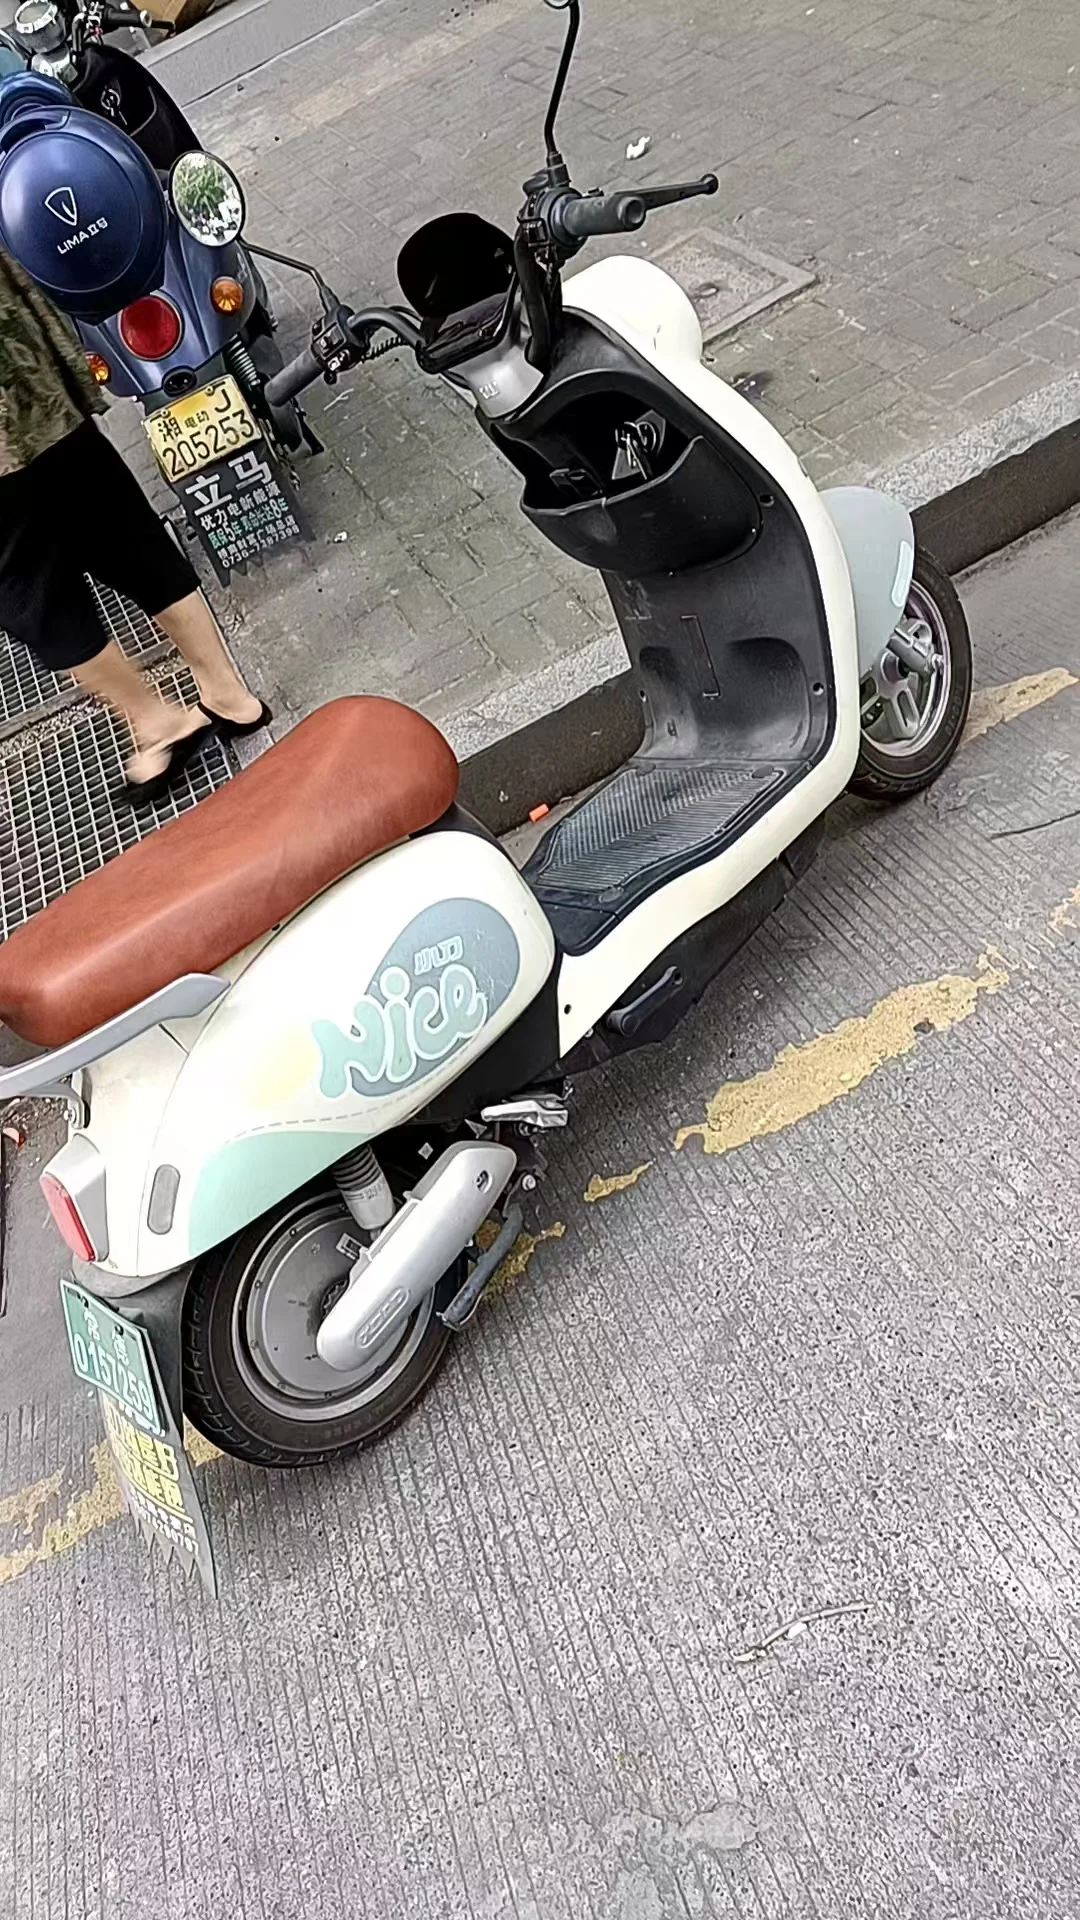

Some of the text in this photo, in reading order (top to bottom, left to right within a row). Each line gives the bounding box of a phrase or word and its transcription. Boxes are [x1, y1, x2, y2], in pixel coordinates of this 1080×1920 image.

[158, 389, 231, 442] 湘 电动 J
[162, 409, 254, 476] 205253
[185, 451, 272, 516] 立马
[200, 481, 281, 531] 优力电新能源
[310, 965, 488, 1100] Nice
[74, 1333, 154, 1420] 0157259
